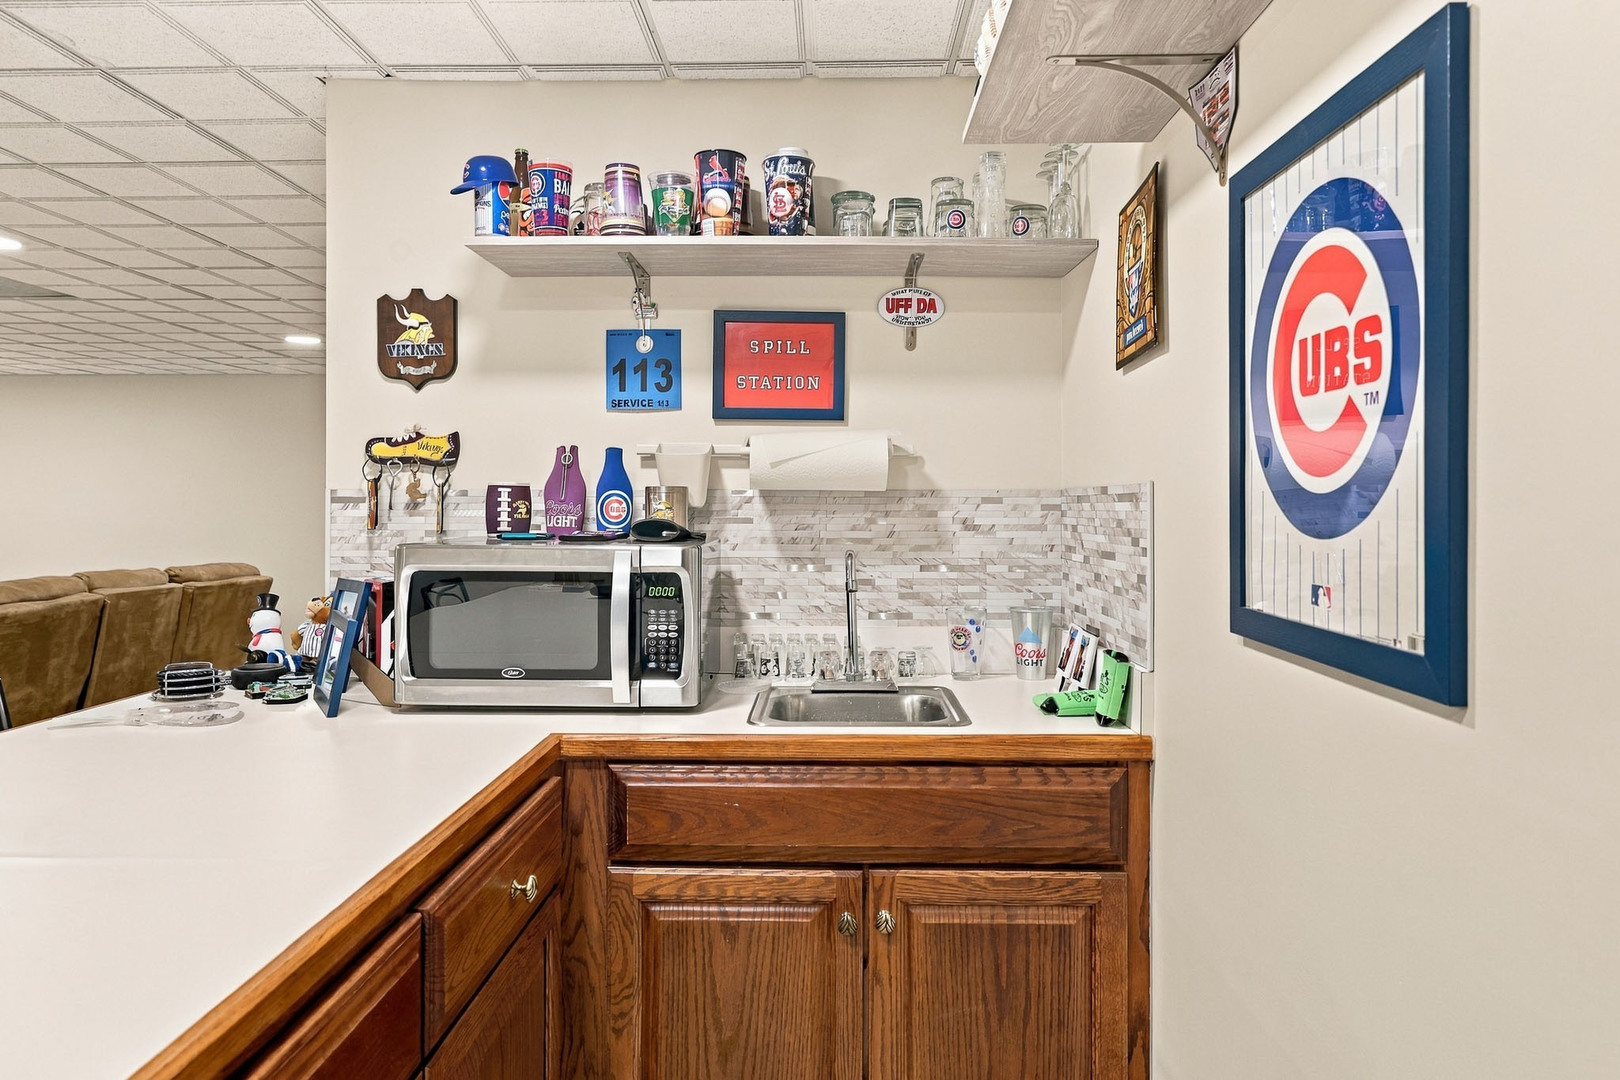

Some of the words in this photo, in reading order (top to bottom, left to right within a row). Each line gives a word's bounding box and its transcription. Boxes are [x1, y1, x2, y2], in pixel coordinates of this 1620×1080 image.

[777, 157, 807, 177] Louis
[886, 298, 912, 313] UFF
[917, 298, 937, 313] DA
[386, 343, 446, 357] VIKINGS
[749, 340, 811, 354] SPILL
[1273, 244, 1383, 478] CUBS
[612, 358, 674, 393] 113
[736, 375, 821, 390] STATION
[611, 399, 654, 408] SERVICE
[1363, 390, 1380, 406] TM
[546, 500, 583, 517] Coors
[648, 586, 676, 597] 0000
[1015, 643, 1046, 659] Coors
[1016, 657, 1044, 667] LIGHT
